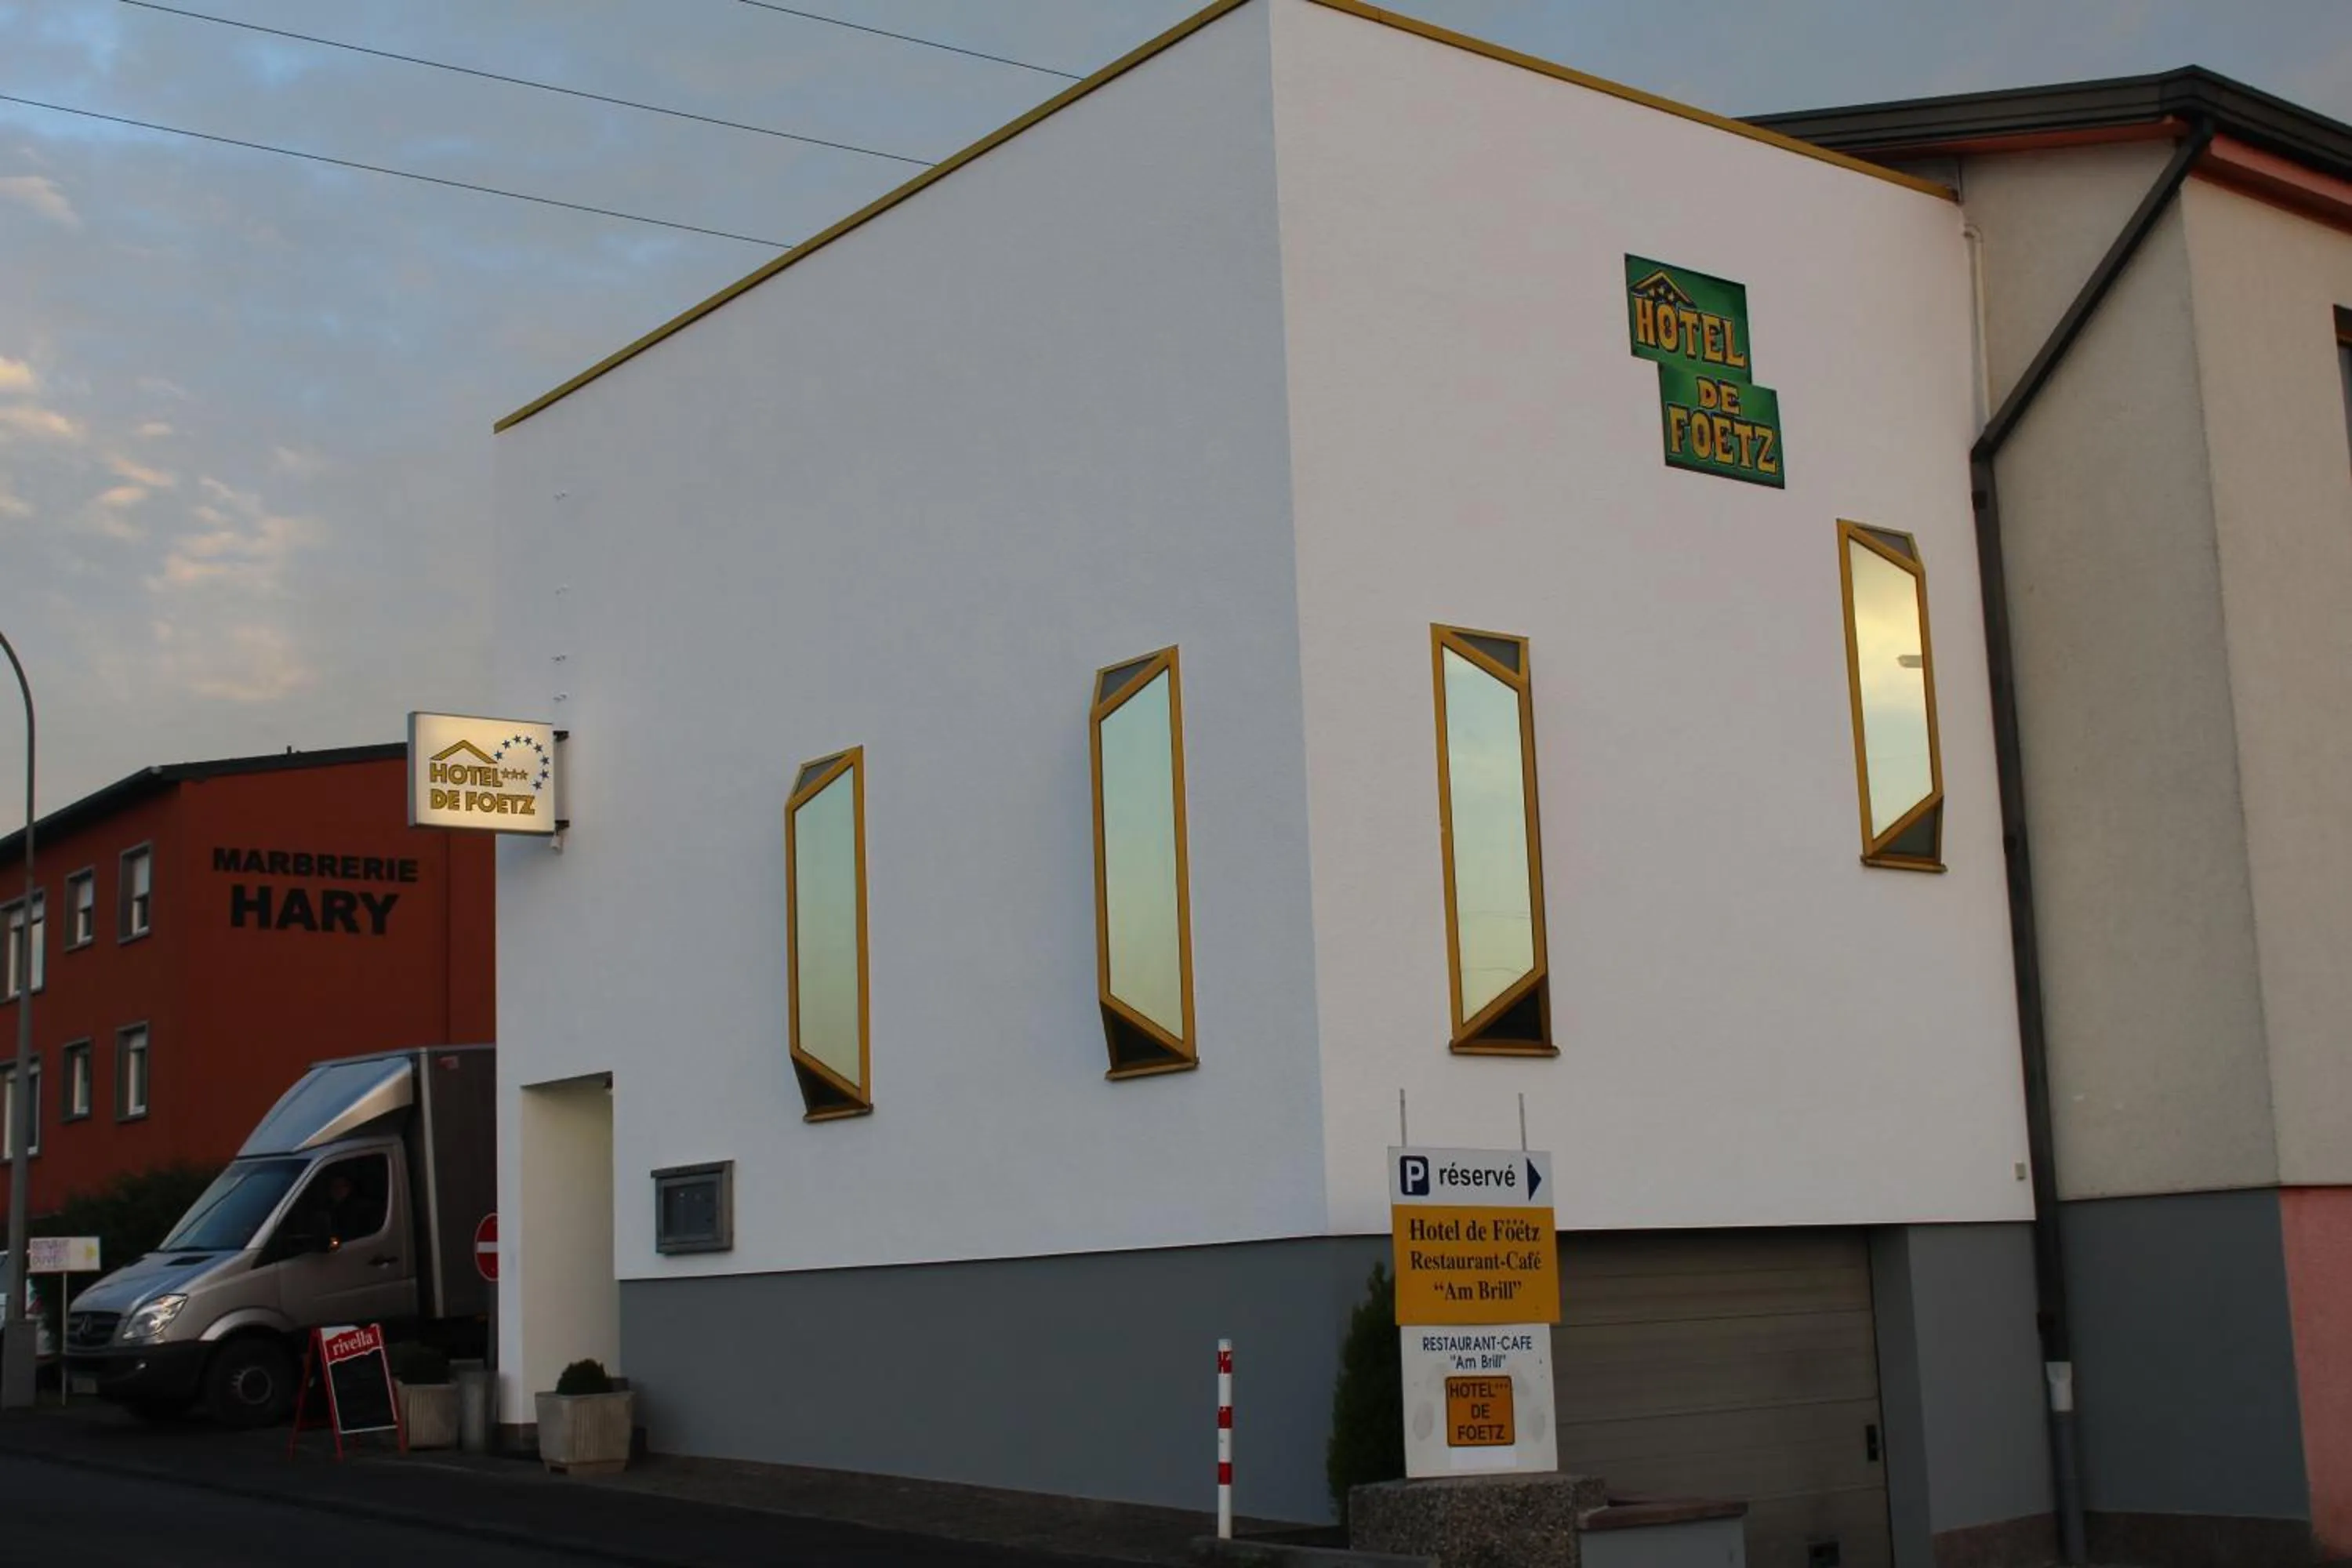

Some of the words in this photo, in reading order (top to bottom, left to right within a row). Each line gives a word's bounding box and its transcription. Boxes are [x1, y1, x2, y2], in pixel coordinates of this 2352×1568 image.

[1634, 295, 1747, 368] HOTEL
[1696, 376, 1741, 415] DE
[1667, 403, 1778, 475] FOETZ
[430, 762, 503, 788] HOTEL
[430, 788, 460, 811] DE
[465, 791, 535, 815] FOETZ
[212, 847, 419, 883] MARBRERIE
[230, 884, 400, 935] HARY
[1439, 1163, 1516, 1187] réservé
[1410, 1218, 1460, 1242] Hotel
[1466, 1220, 1487, 1241] de
[1410, 1250, 1542, 1271] Restaurant-Café
[332, 1331, 374, 1356] rivella
[1422, 1335, 1533, 1352] RESTAURANT-CAFE
[1450, 1383, 1497, 1399] HOTEL
[1471, 1404, 1490, 1420] DE
[1457, 1425, 1506, 1441] FOETZ
